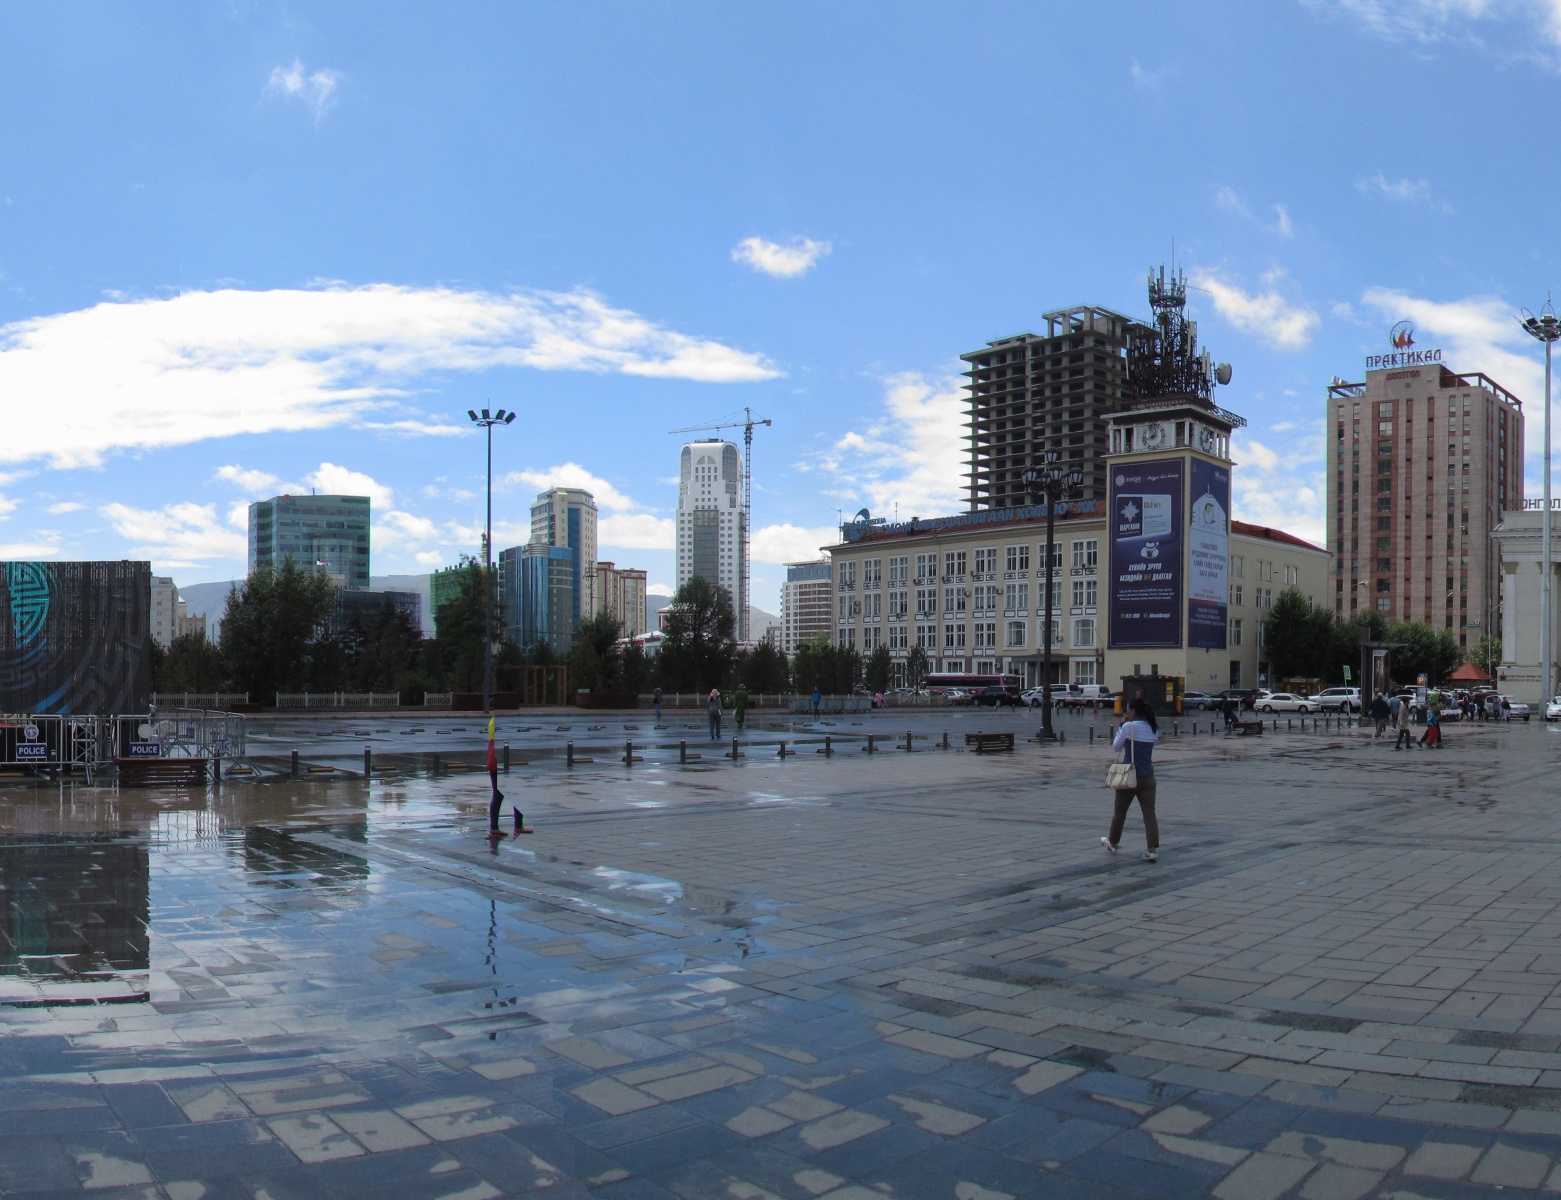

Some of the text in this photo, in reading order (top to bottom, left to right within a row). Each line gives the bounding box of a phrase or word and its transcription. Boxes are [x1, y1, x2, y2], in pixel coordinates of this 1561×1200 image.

[1366, 349, 1442, 368] ПРАКТИКАЛ
[18, 746, 45, 755] POLICE
[131, 745, 158, 754] POLICE
